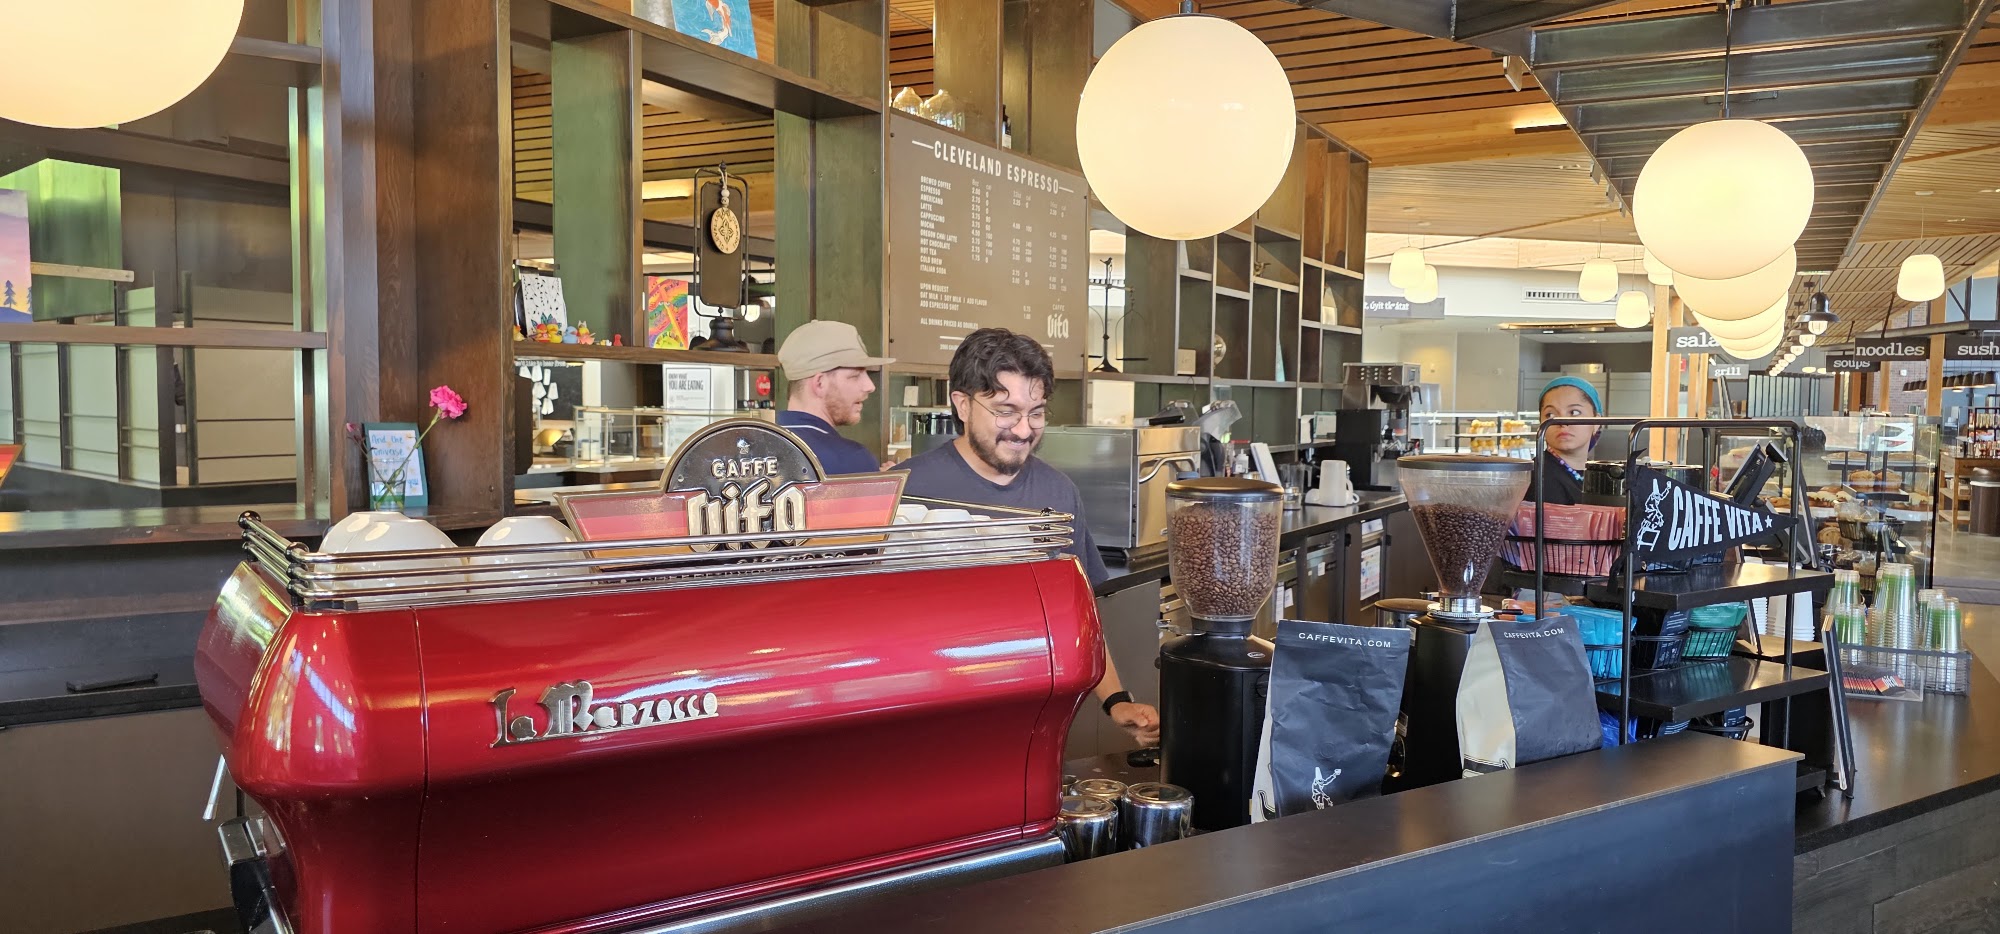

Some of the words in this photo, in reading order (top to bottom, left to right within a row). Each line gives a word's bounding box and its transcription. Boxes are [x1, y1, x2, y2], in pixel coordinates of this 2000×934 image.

[934, 140, 1001, 176] CLEVELAND
[1008, 164, 1058, 194] ESPRESSO
[920, 176, 937, 186] BREWED
[938, 180, 952, 190] COFFEE
[920, 184, 940, 196] ESPRESSO
[920, 194, 944, 205] AMERICANO
[920, 202, 932, 212] LATTE
[920, 211, 945, 223] CAPPUCCINO
[920, 220, 934, 229] MOCHA
[920, 229, 936, 238] OREGON
[936, 232, 946, 240] CHAI
[946, 234, 958, 243] LATTE
[929, 240, 950, 250] CHOCOLATE
[920, 256, 930, 264] COLD
[931, 258, 942, 266] BREW
[920, 264, 936, 272] ITALIAN
[936, 266, 946, 274] SODA
[932, 284, 948, 292] REQUEST
[929, 300, 948, 310] ESPRESSO
[928, 318, 942, 326] DRINKS
[944, 320, 956, 328] PRICED
[962, 322, 978, 330] DOUBLES
[1676, 332, 1720, 348] sala
[1856, 342, 1924, 356] noodles
[1958, 342, 2000, 356] sush
[1833, 359, 1870, 370] soups
[1714, 366, 1742, 376] grill
[669, 380, 678, 390] YOU
[678, 380, 688, 390] ARE
[688, 380, 704, 390] EATING
[372, 434, 387, 445] And
[390, 434, 404, 444] the
[373, 448, 404, 456] universe
[711, 456, 778, 478] CAFFE
[1668, 485, 1722, 551] CAFFE
[1724, 504, 1763, 540] VITA
[1503, 627, 1566, 640] CAFFEVITA.COM
[1298, 632, 1392, 648] CAFFEVITA.COM
